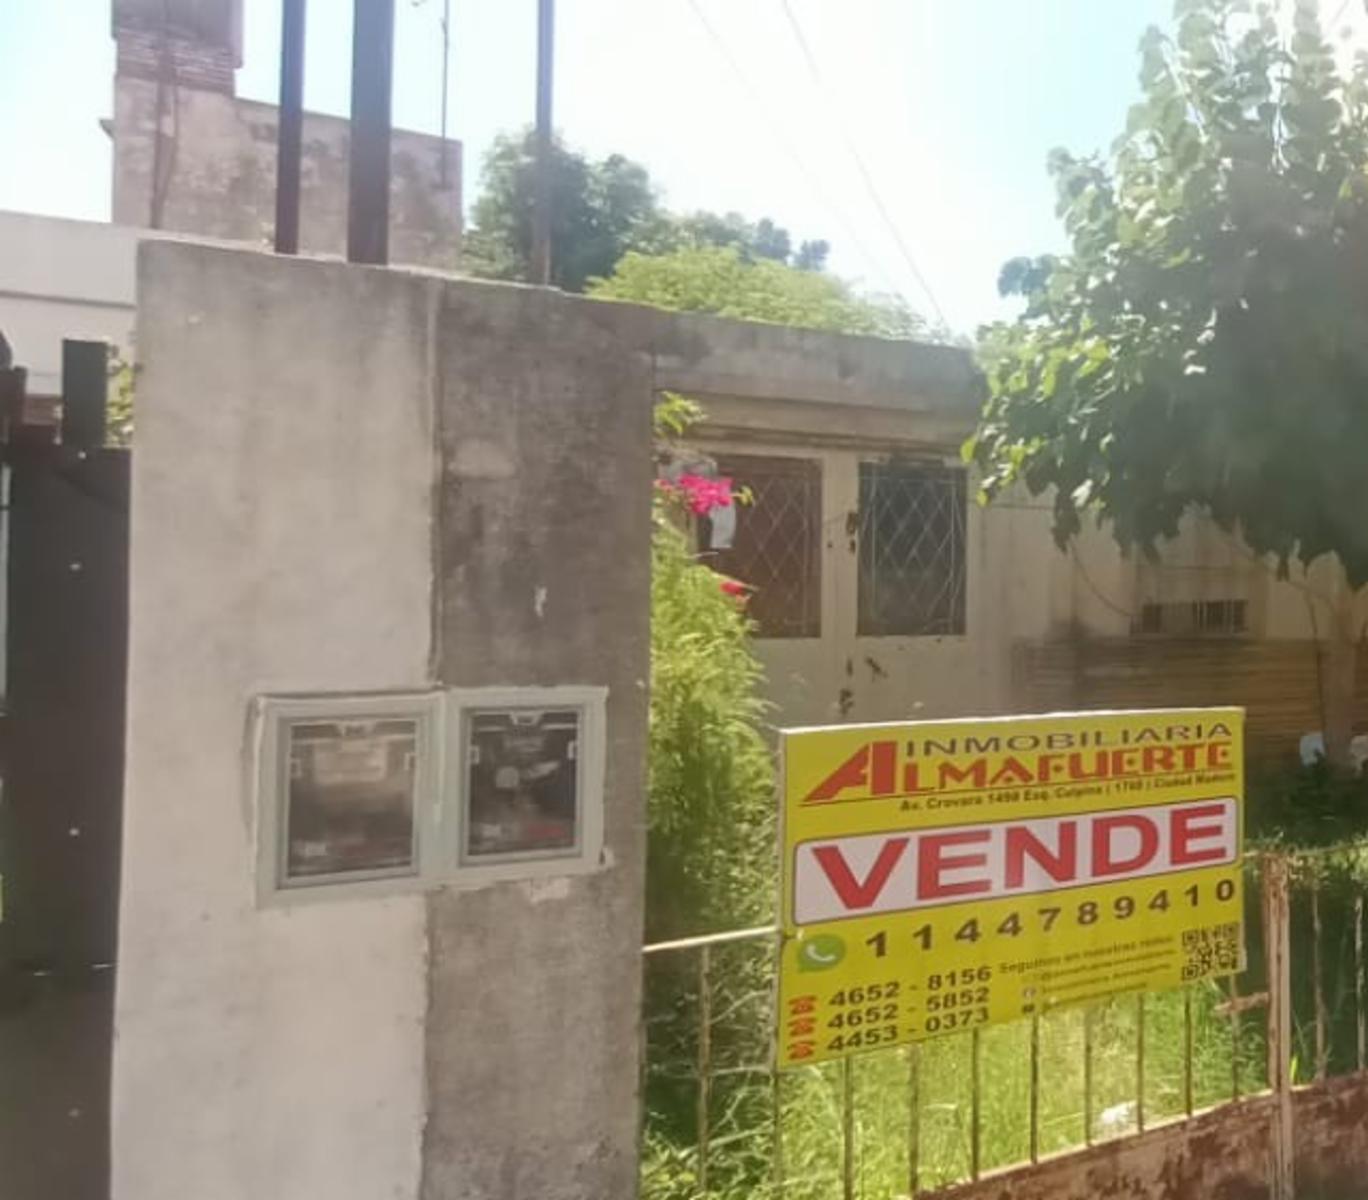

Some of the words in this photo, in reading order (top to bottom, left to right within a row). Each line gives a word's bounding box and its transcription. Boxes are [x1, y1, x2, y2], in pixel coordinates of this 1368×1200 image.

[906, 722, 1232, 757] INMOBILIARIA
[803, 740, 1232, 804] ALMAFUERTE
[813, 804, 1228, 910] VENDE
[865, 880, 1235, 958] 1144789410
[827, 1003, 899, 1029] 4652
[926, 987, 990, 1012] 5852
[829, 981, 900, 1006] 4652
[927, 966, 992, 990] 8156
[827, 1025, 899, 1051] 4453
[925, 1007, 990, 1033] 0373
